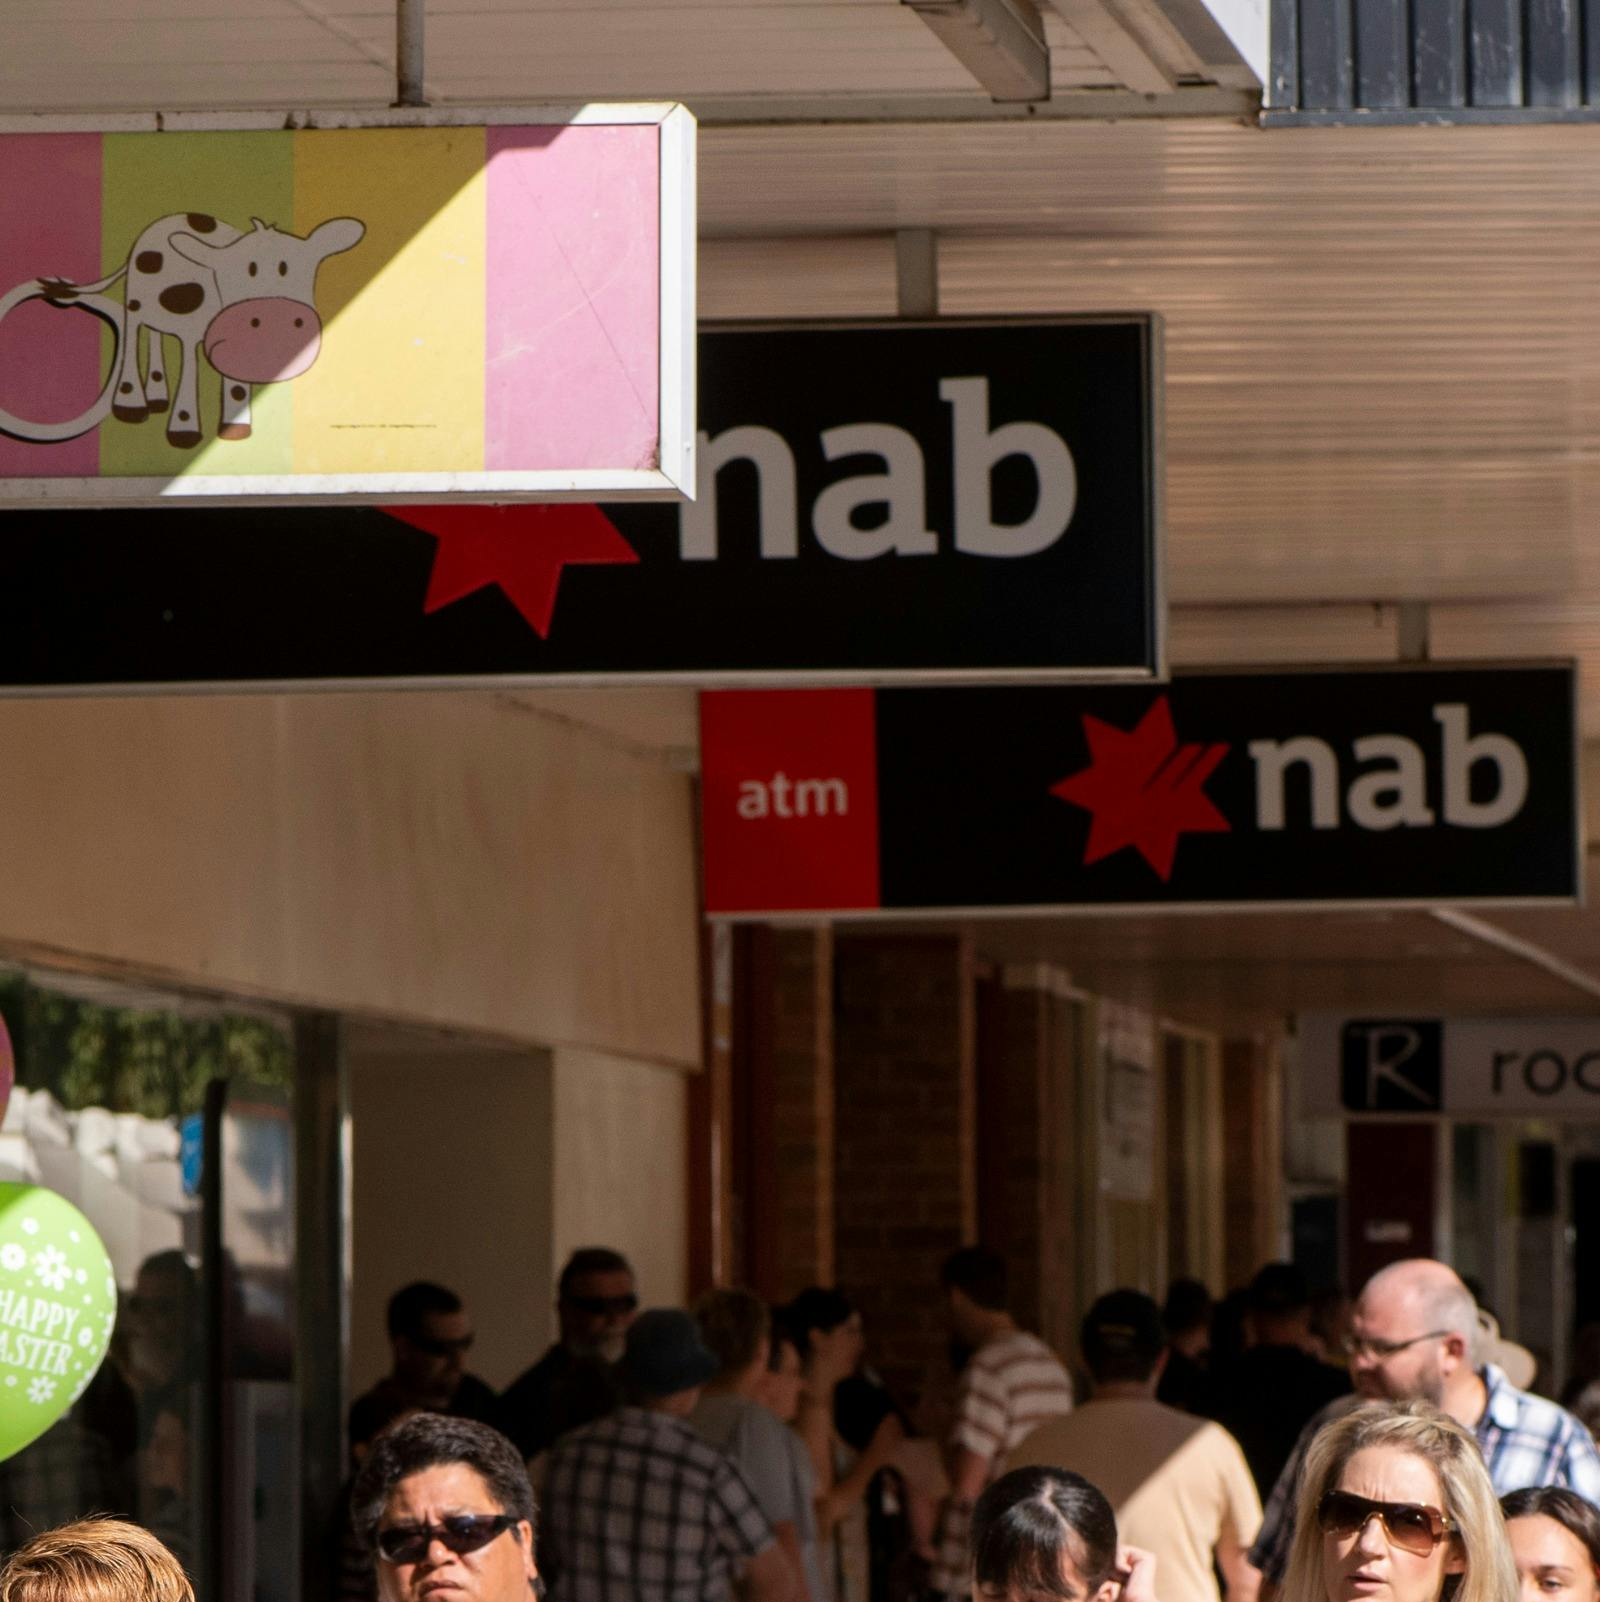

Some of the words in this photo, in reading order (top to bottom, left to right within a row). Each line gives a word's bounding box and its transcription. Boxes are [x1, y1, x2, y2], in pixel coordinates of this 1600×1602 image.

[679, 376, 1078, 561] nab
[736, 771, 849, 819] atm
[1248, 703, 1530, 831] nab
